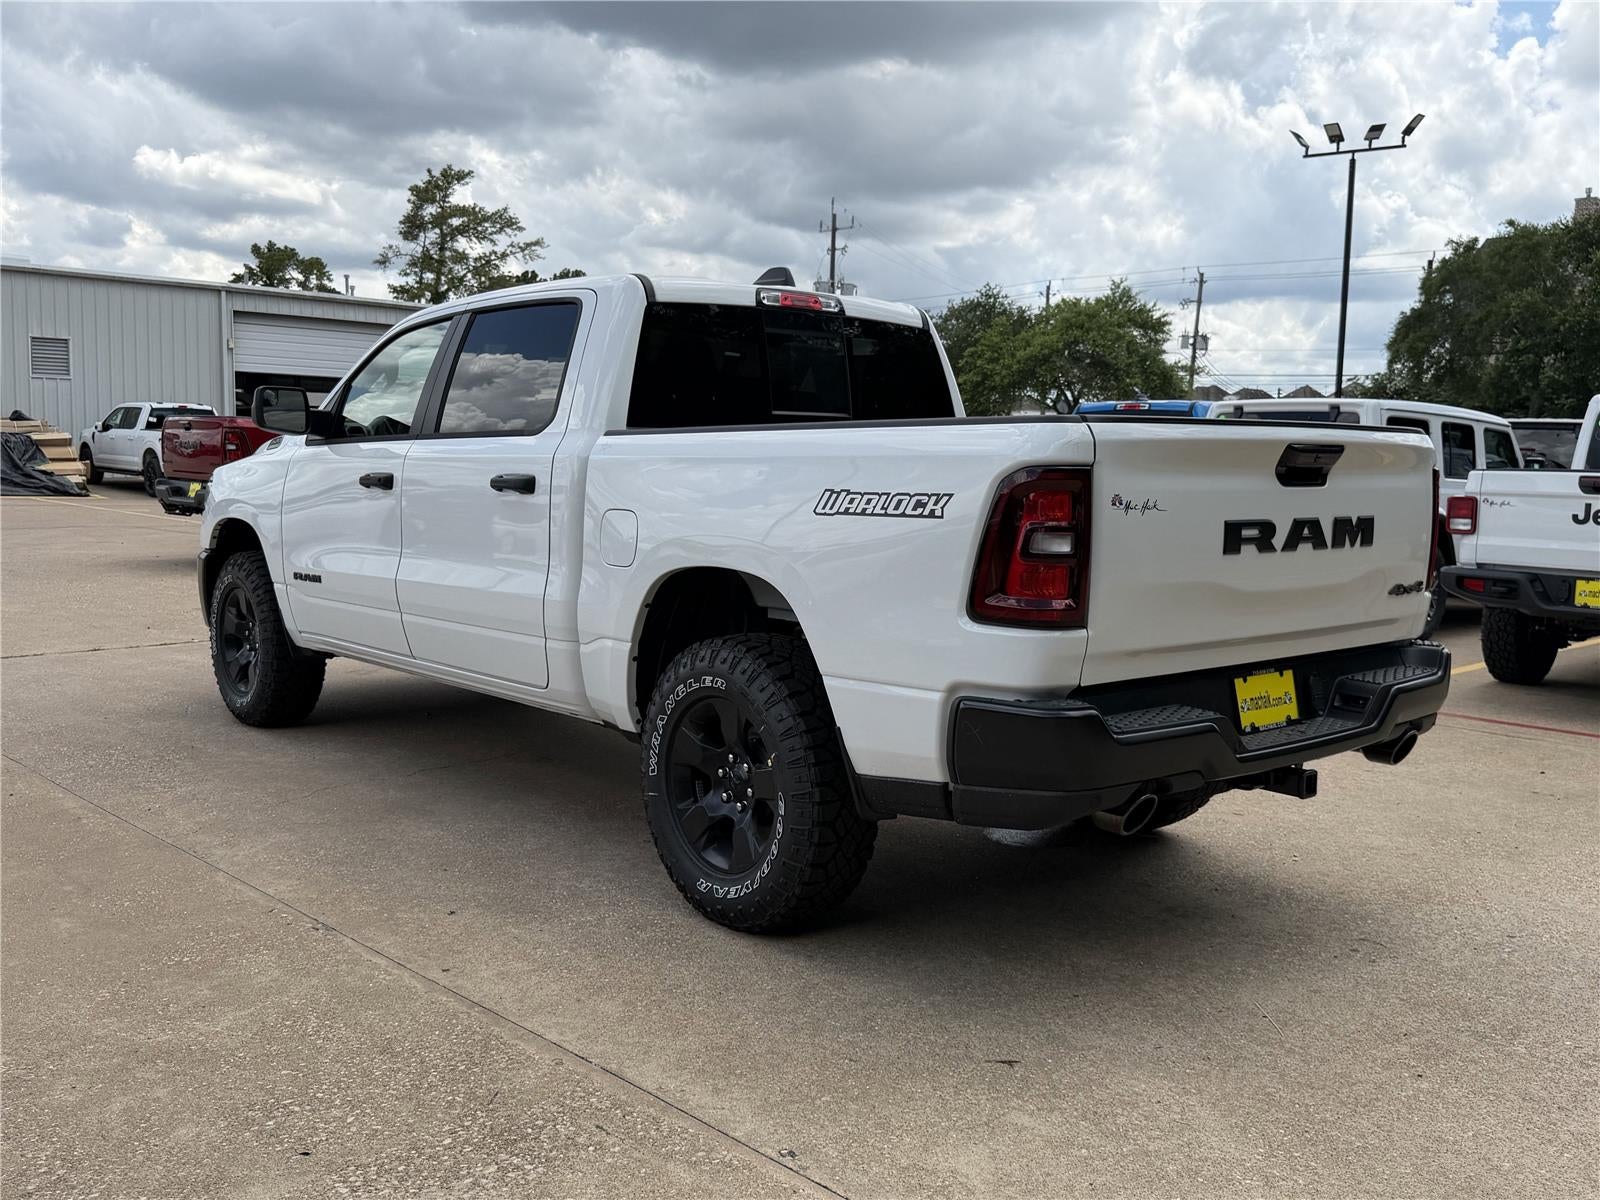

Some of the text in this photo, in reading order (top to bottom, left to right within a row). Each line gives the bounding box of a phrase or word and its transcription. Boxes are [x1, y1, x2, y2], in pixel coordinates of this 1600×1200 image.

[813, 488, 954, 519] WARLOCK
[1223, 515, 1375, 556] RAM
[649, 676, 726, 776] WRANGLER
[697, 791, 785, 899] GOODYEAR
